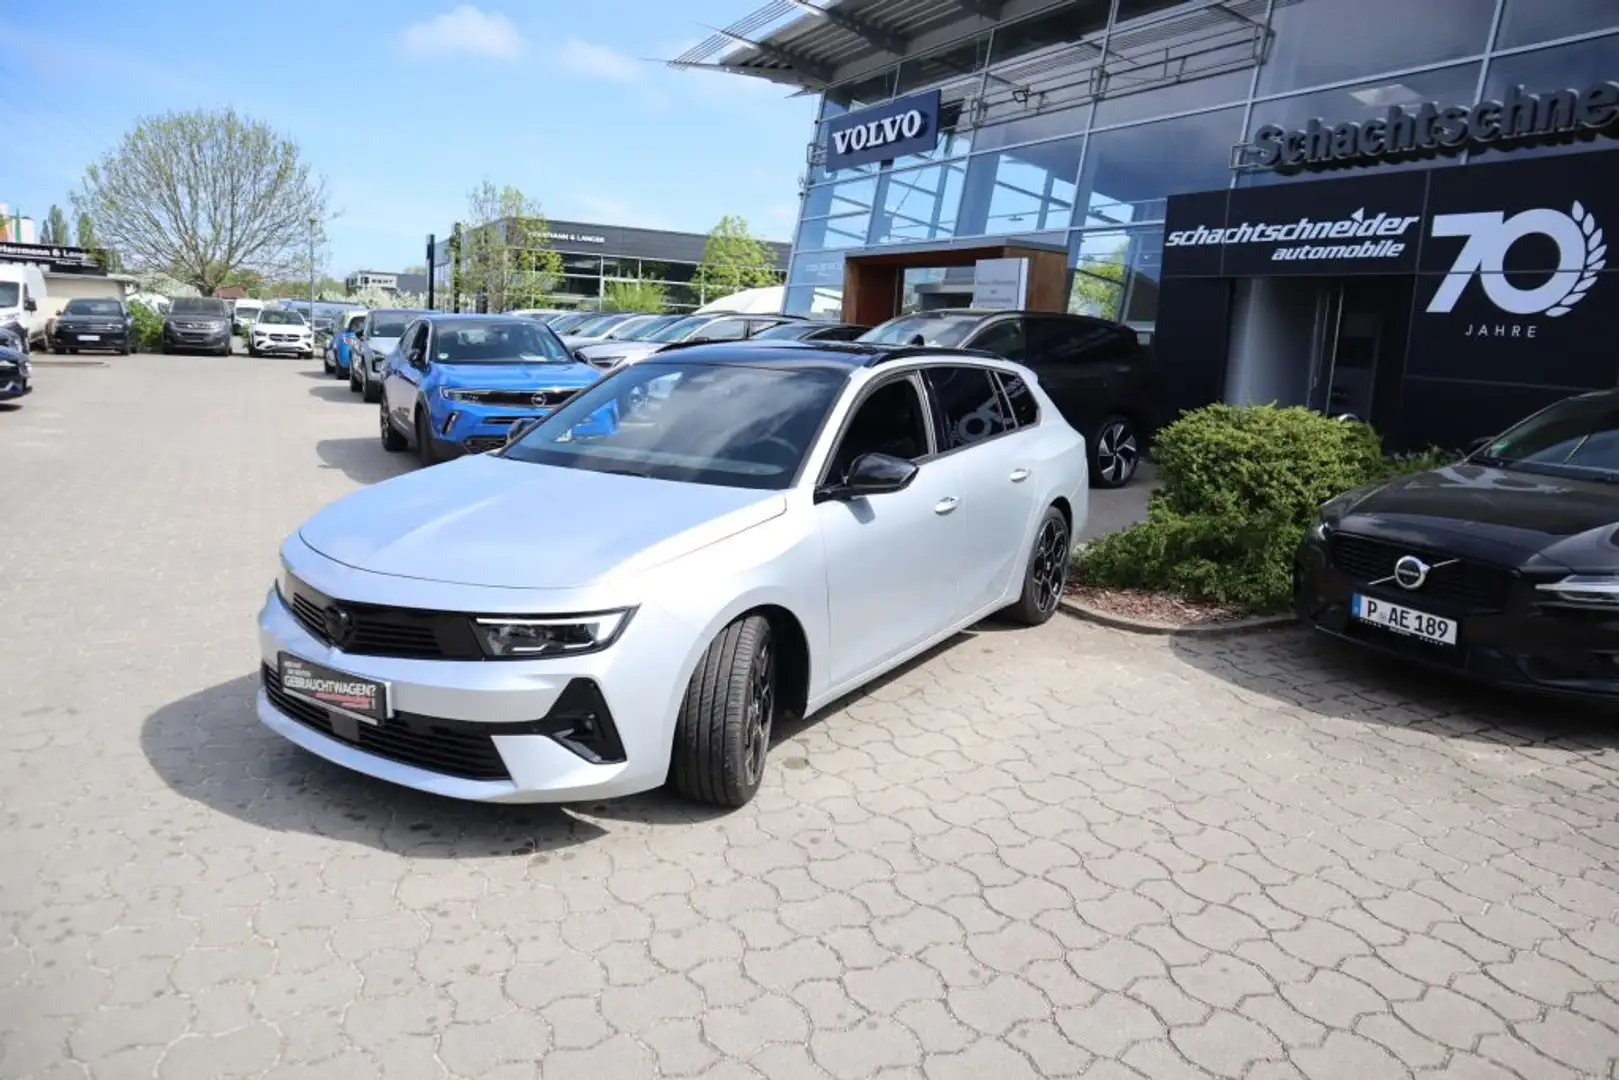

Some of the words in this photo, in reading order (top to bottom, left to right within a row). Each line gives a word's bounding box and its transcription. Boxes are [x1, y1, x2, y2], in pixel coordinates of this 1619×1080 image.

[832, 109, 921, 154] VOLVO
[1253, 82, 1619, 167] Schachtschne
[1165, 207, 1420, 246] schachtschneider
[1271, 240, 1406, 261] automobile
[1425, 208, 1587, 315] 70
[1464, 323, 1538, 339] JAHRE
[1367, 600, 1378, 618] P
[1388, 606, 1411, 630] AE
[1414, 614, 1449, 639] 189
[284, 675, 377, 697] GEBRAUCHTWAGEN?
